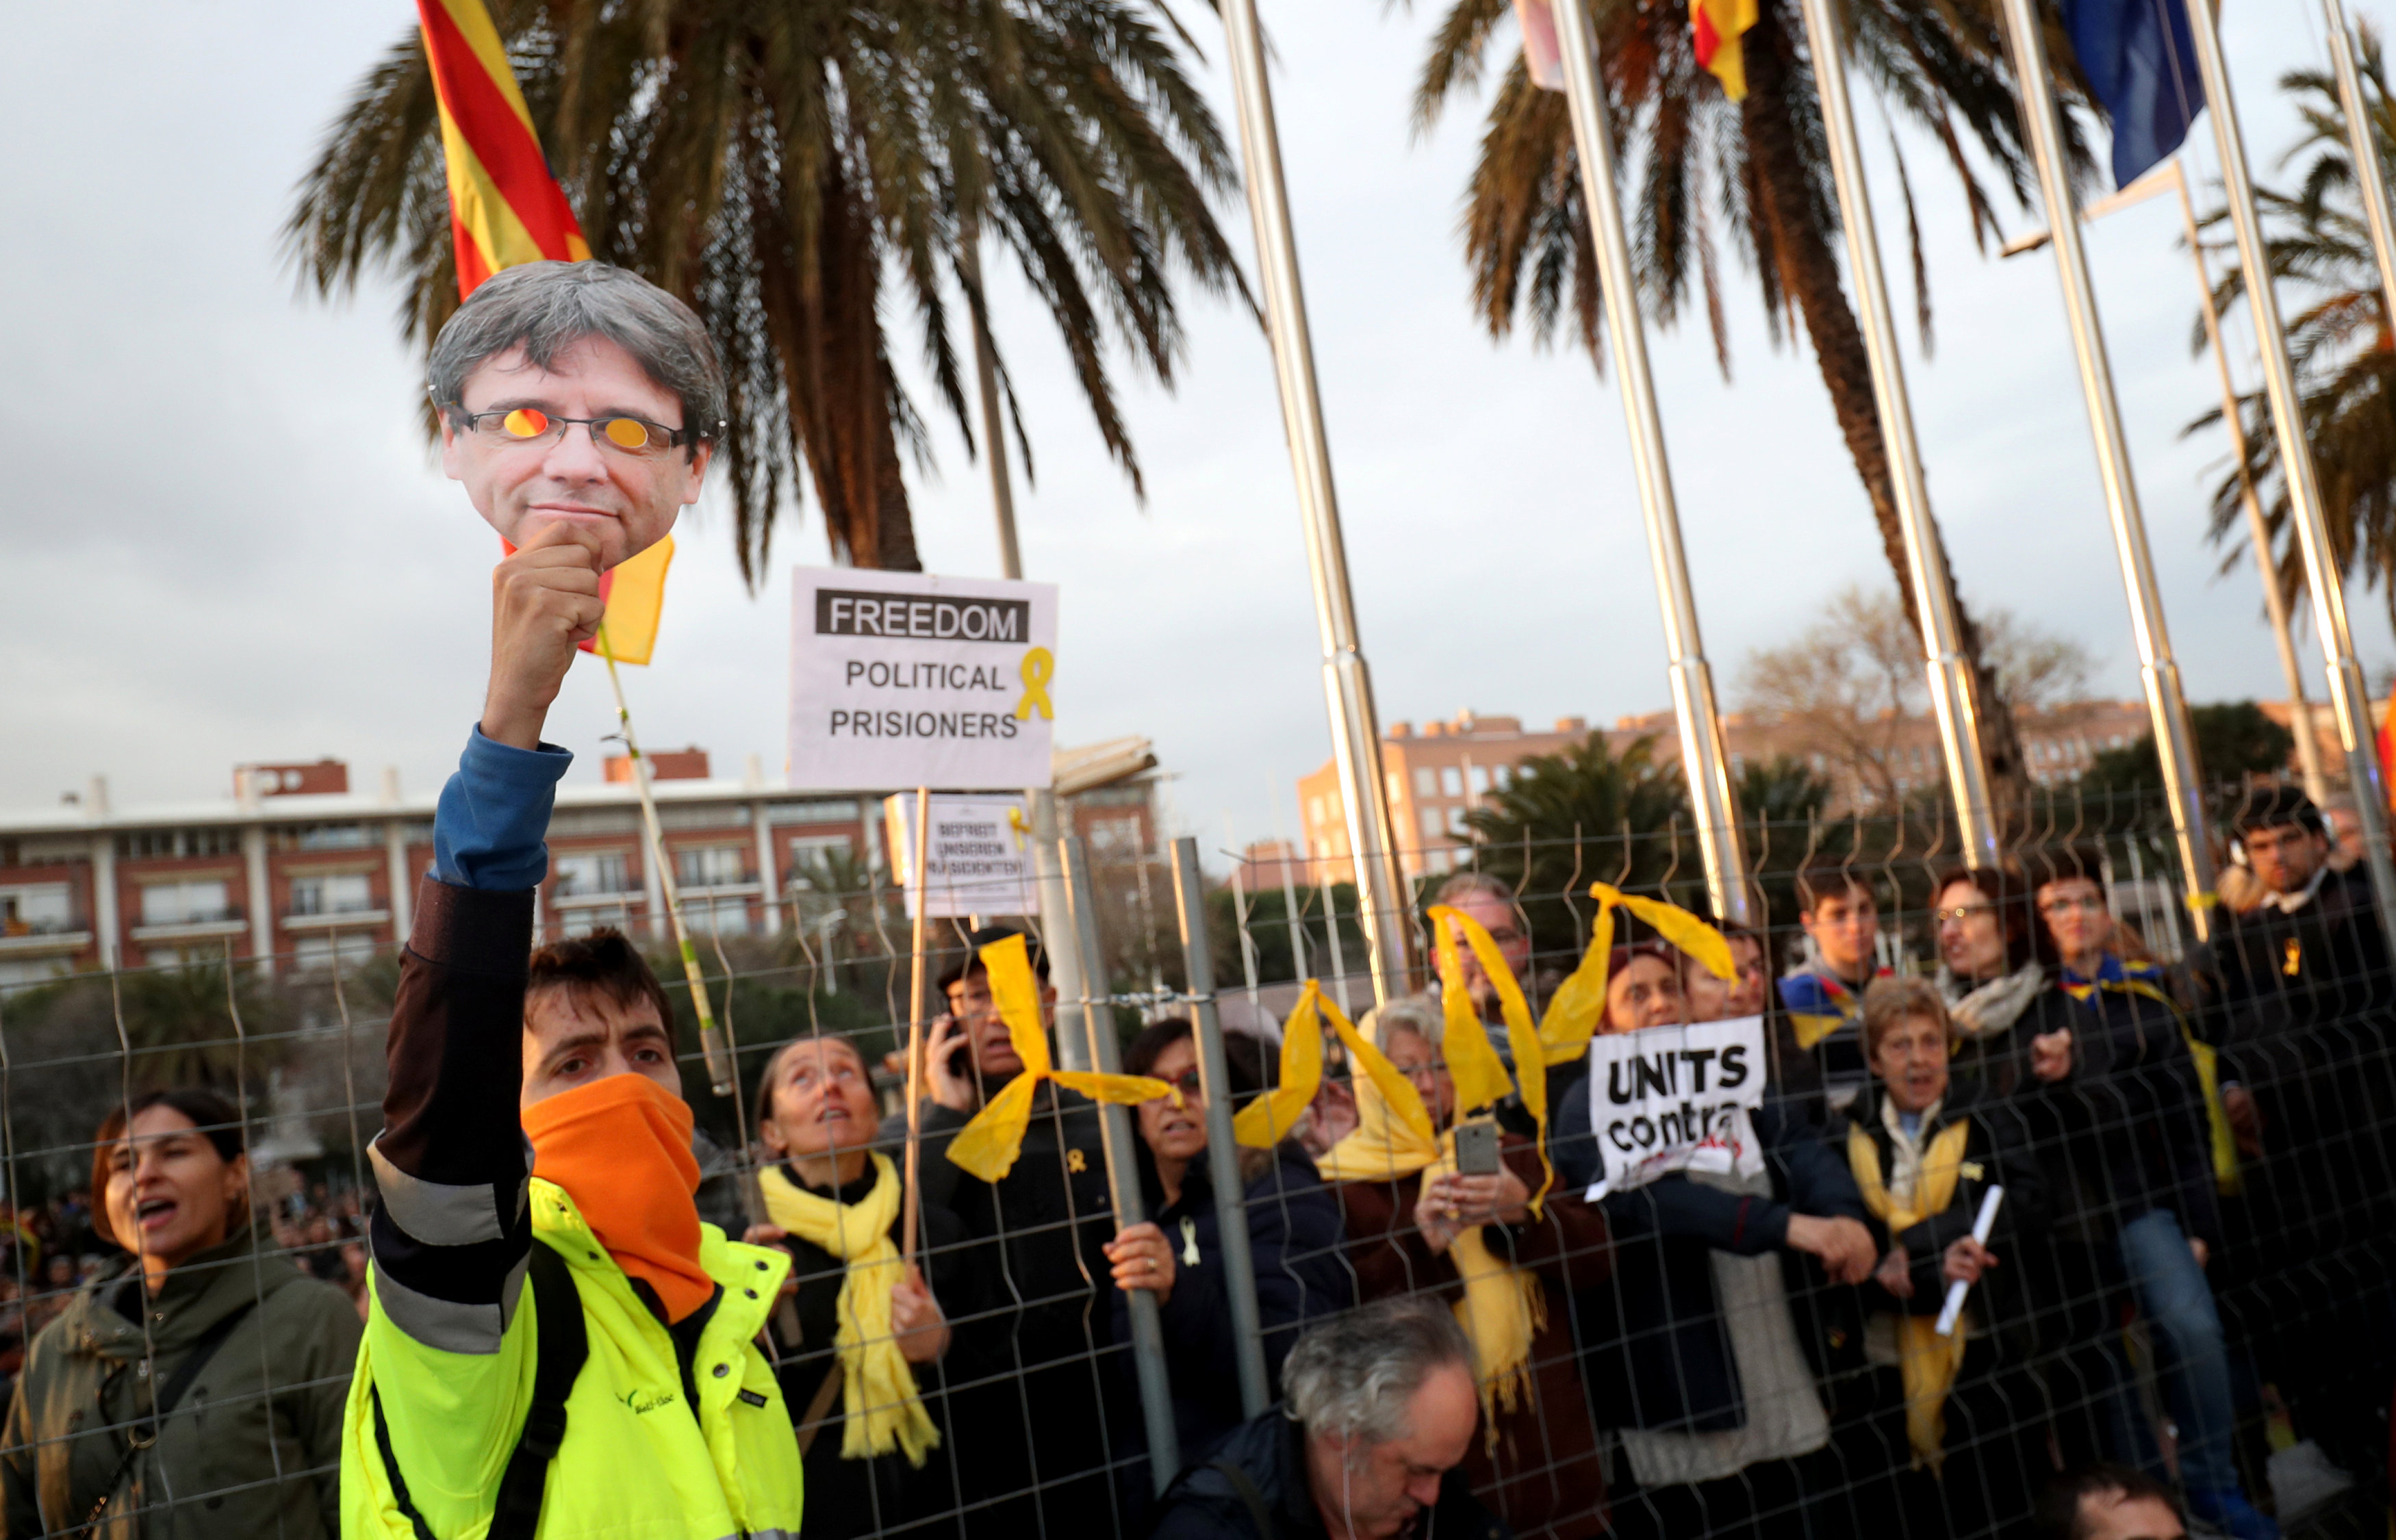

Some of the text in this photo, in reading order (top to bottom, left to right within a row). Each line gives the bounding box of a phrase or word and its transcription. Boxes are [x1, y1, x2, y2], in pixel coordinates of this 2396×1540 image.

[830, 597, 1018, 641] FREEDOM
[846, 660, 1007, 691] POLITICAL
[830, 710, 1019, 739] PRISIONERS
[1608, 1045, 1748, 1105] UNITS
